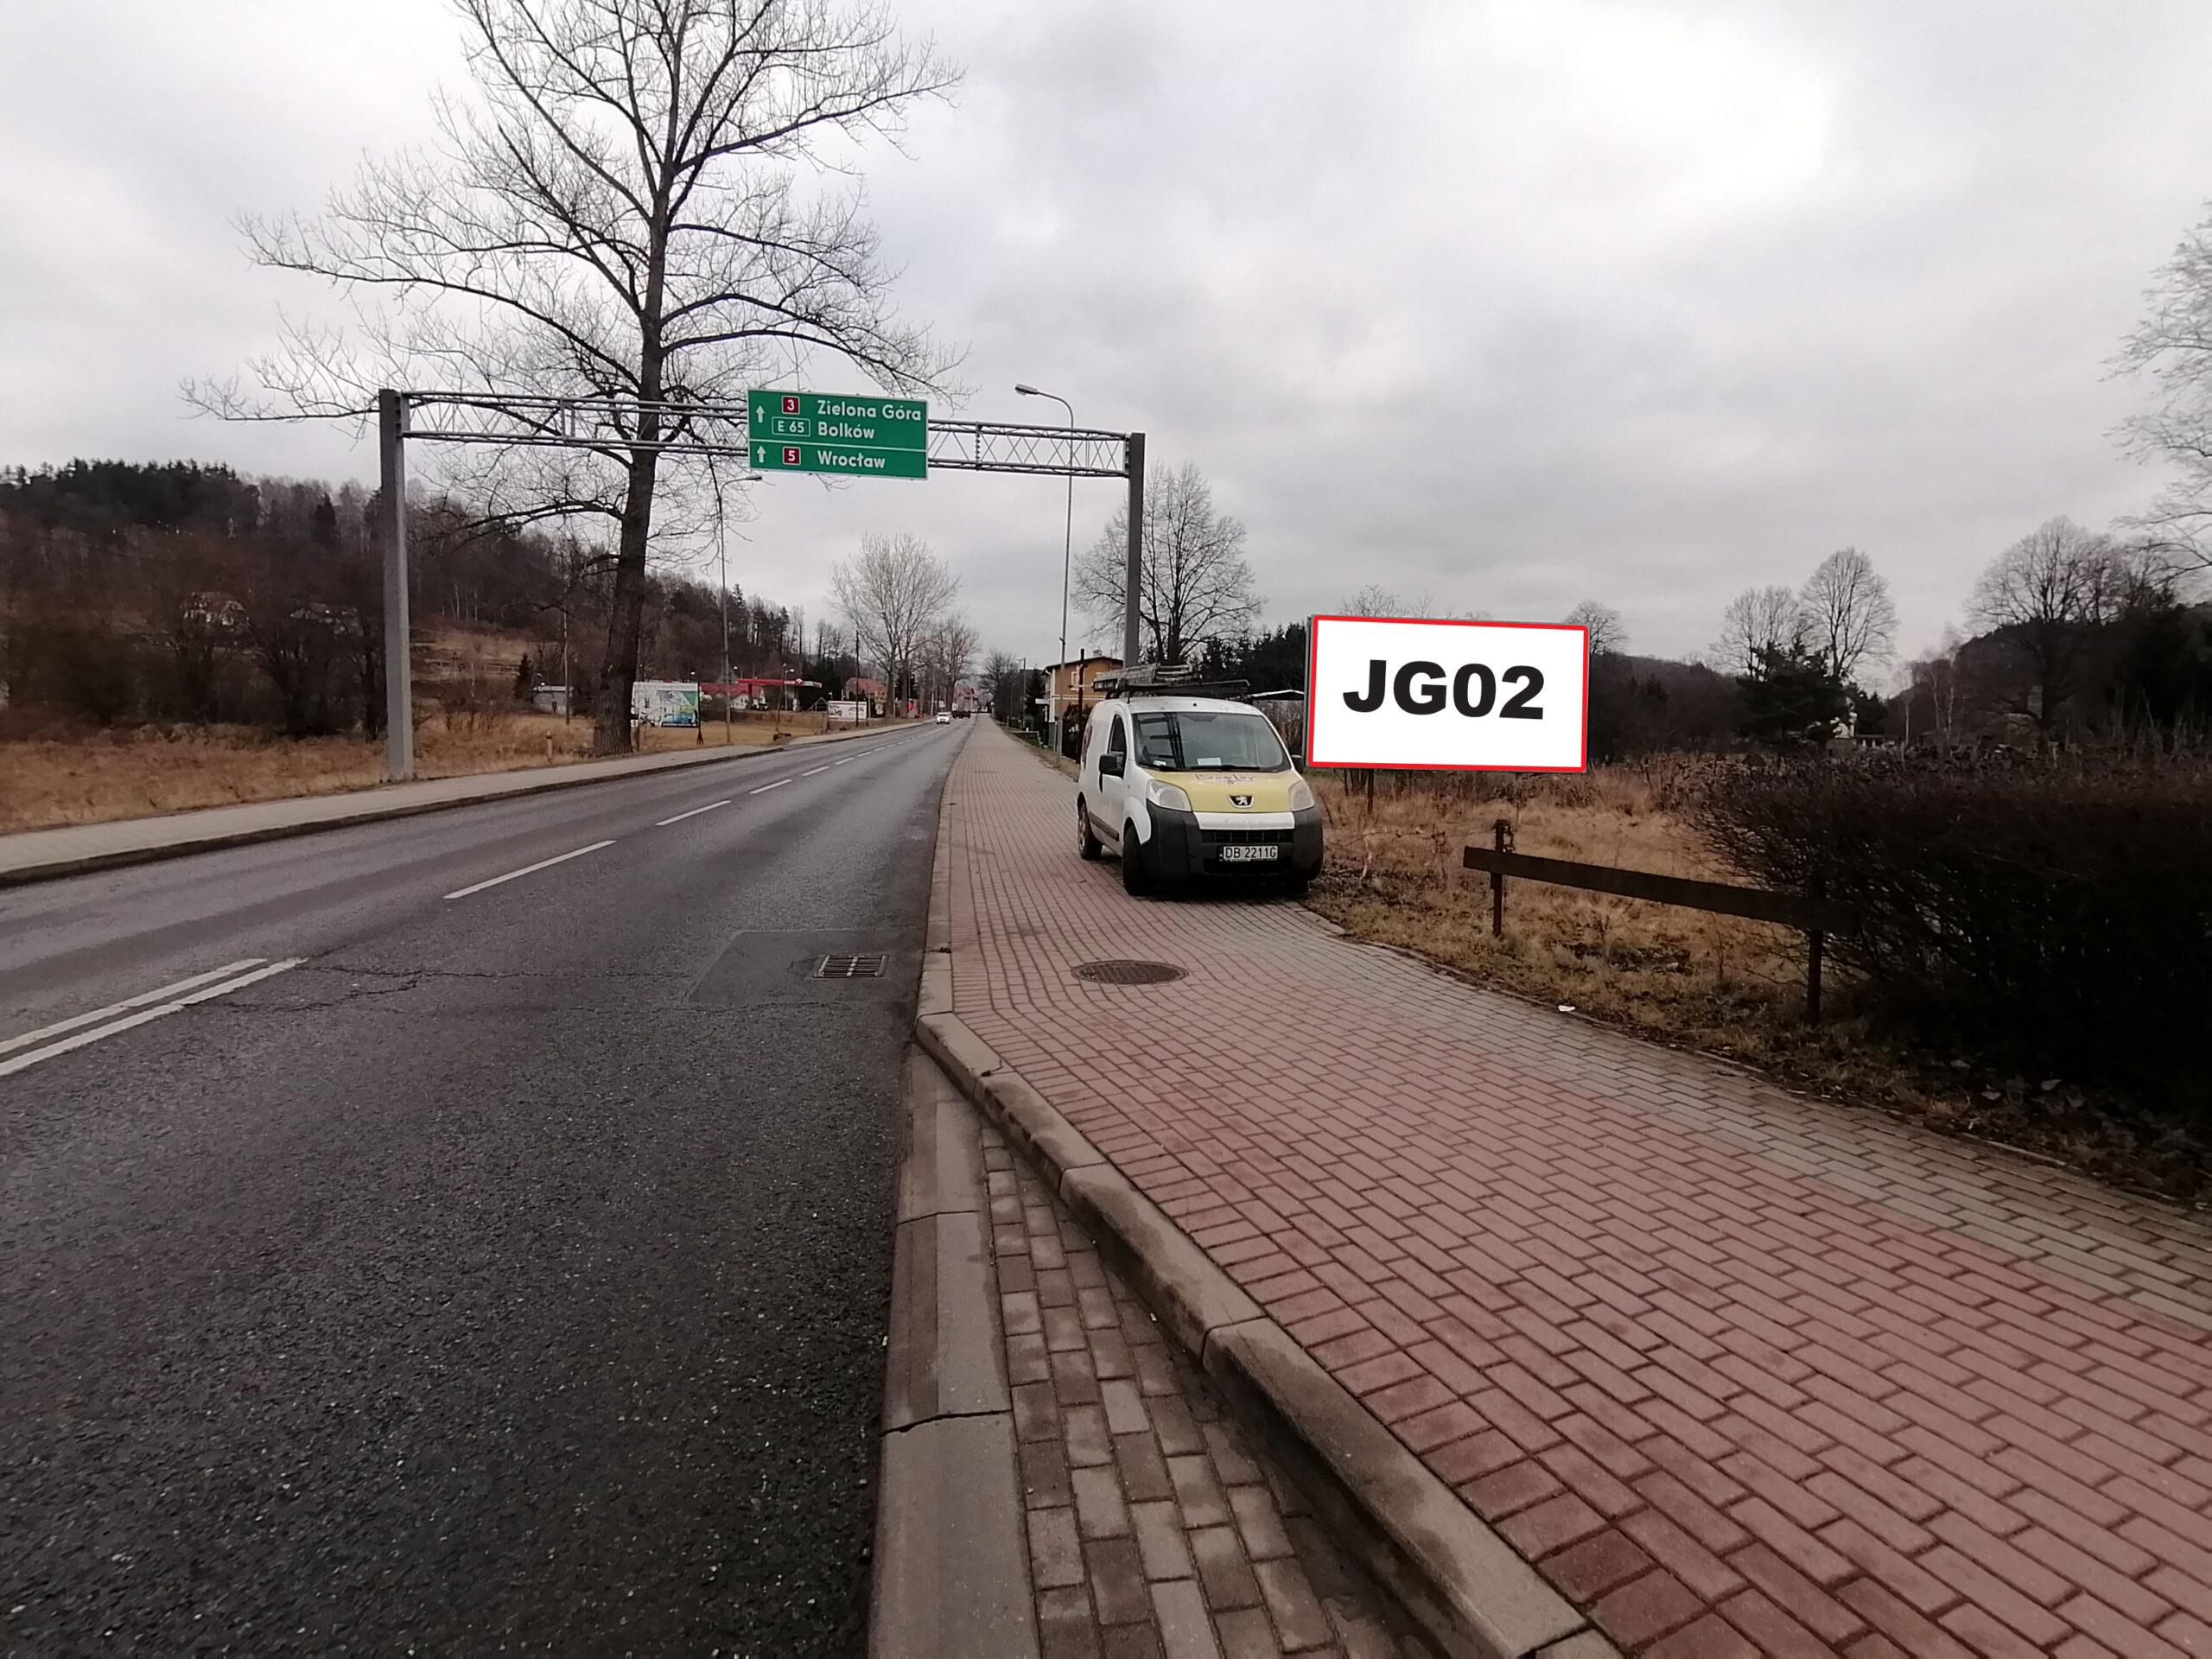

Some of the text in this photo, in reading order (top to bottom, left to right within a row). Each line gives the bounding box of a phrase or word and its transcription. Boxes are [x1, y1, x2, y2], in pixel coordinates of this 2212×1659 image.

[787, 399, 795, 411] 3
[817, 399, 922, 421] Zielona Góra
[778, 420, 805, 434] E 65
[817, 421, 875, 440] Bolków
[788, 450, 796, 462] 5
[817, 450, 886, 469] Wrocław
[1225, 847, 1276, 859] DB 2211G
